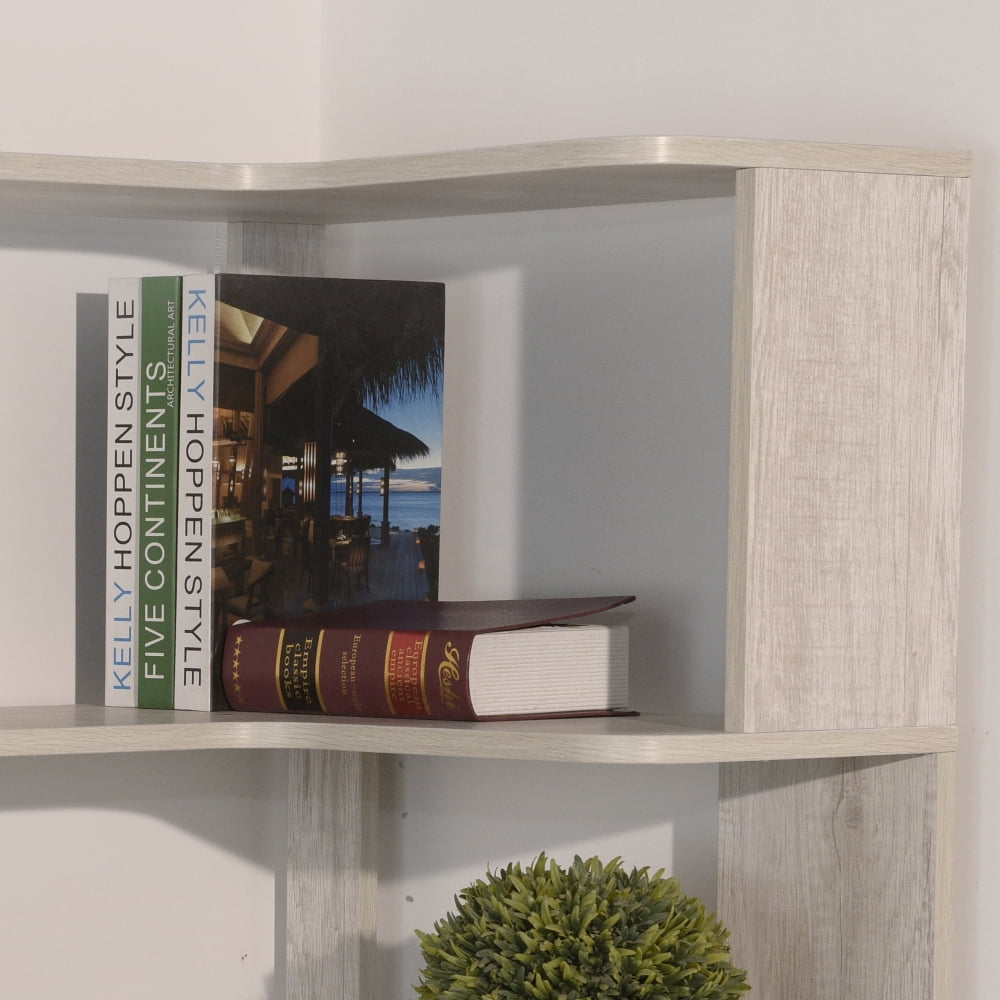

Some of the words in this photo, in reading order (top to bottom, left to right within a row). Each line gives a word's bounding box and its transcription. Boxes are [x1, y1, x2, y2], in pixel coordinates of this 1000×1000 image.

[115, 299, 135, 411] STYLE
[168, 299, 176, 319] ART
[187, 289, 207, 402] KELLY
[166, 322, 176, 408] ARCHITECTURAL
[114, 423, 133, 570] HOPPEN
[144, 360, 167, 591] CONTINENTS
[184, 413, 205, 563] HOPPEN
[113, 581, 133, 691] KELLY
[144, 604, 165, 679] FIVE
[183, 575, 203, 687] STYLE
[283, 643, 294, 700] books
[292, 642, 301, 700] classic
[301, 636, 314, 705] Empire
